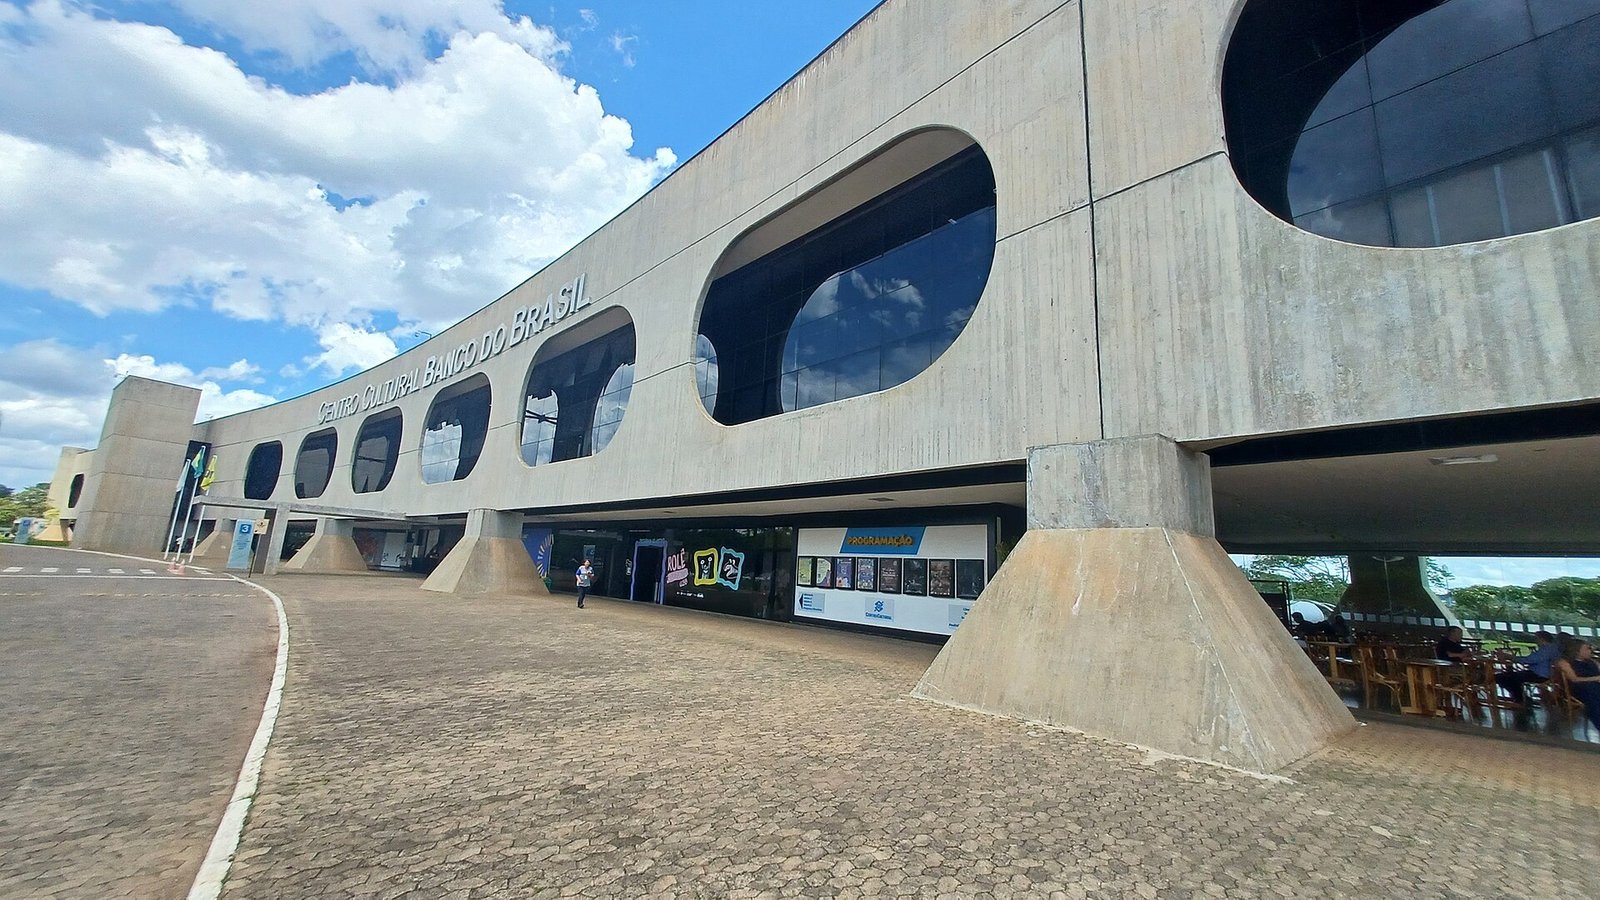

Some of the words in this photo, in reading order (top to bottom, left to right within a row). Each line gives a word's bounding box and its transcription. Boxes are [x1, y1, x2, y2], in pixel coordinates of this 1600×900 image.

[318, 393, 359, 424] CENTRO
[363, 367, 420, 410] CULTURAL
[422, 339, 478, 388] BANCO
[479, 323, 507, 363] DO
[510, 273, 591, 348] BRASIL
[241, 525, 249, 533] 3
[847, 534, 913, 547] PROGRAMAÇÃO
[667, 547, 686, 572] ROLÊ
